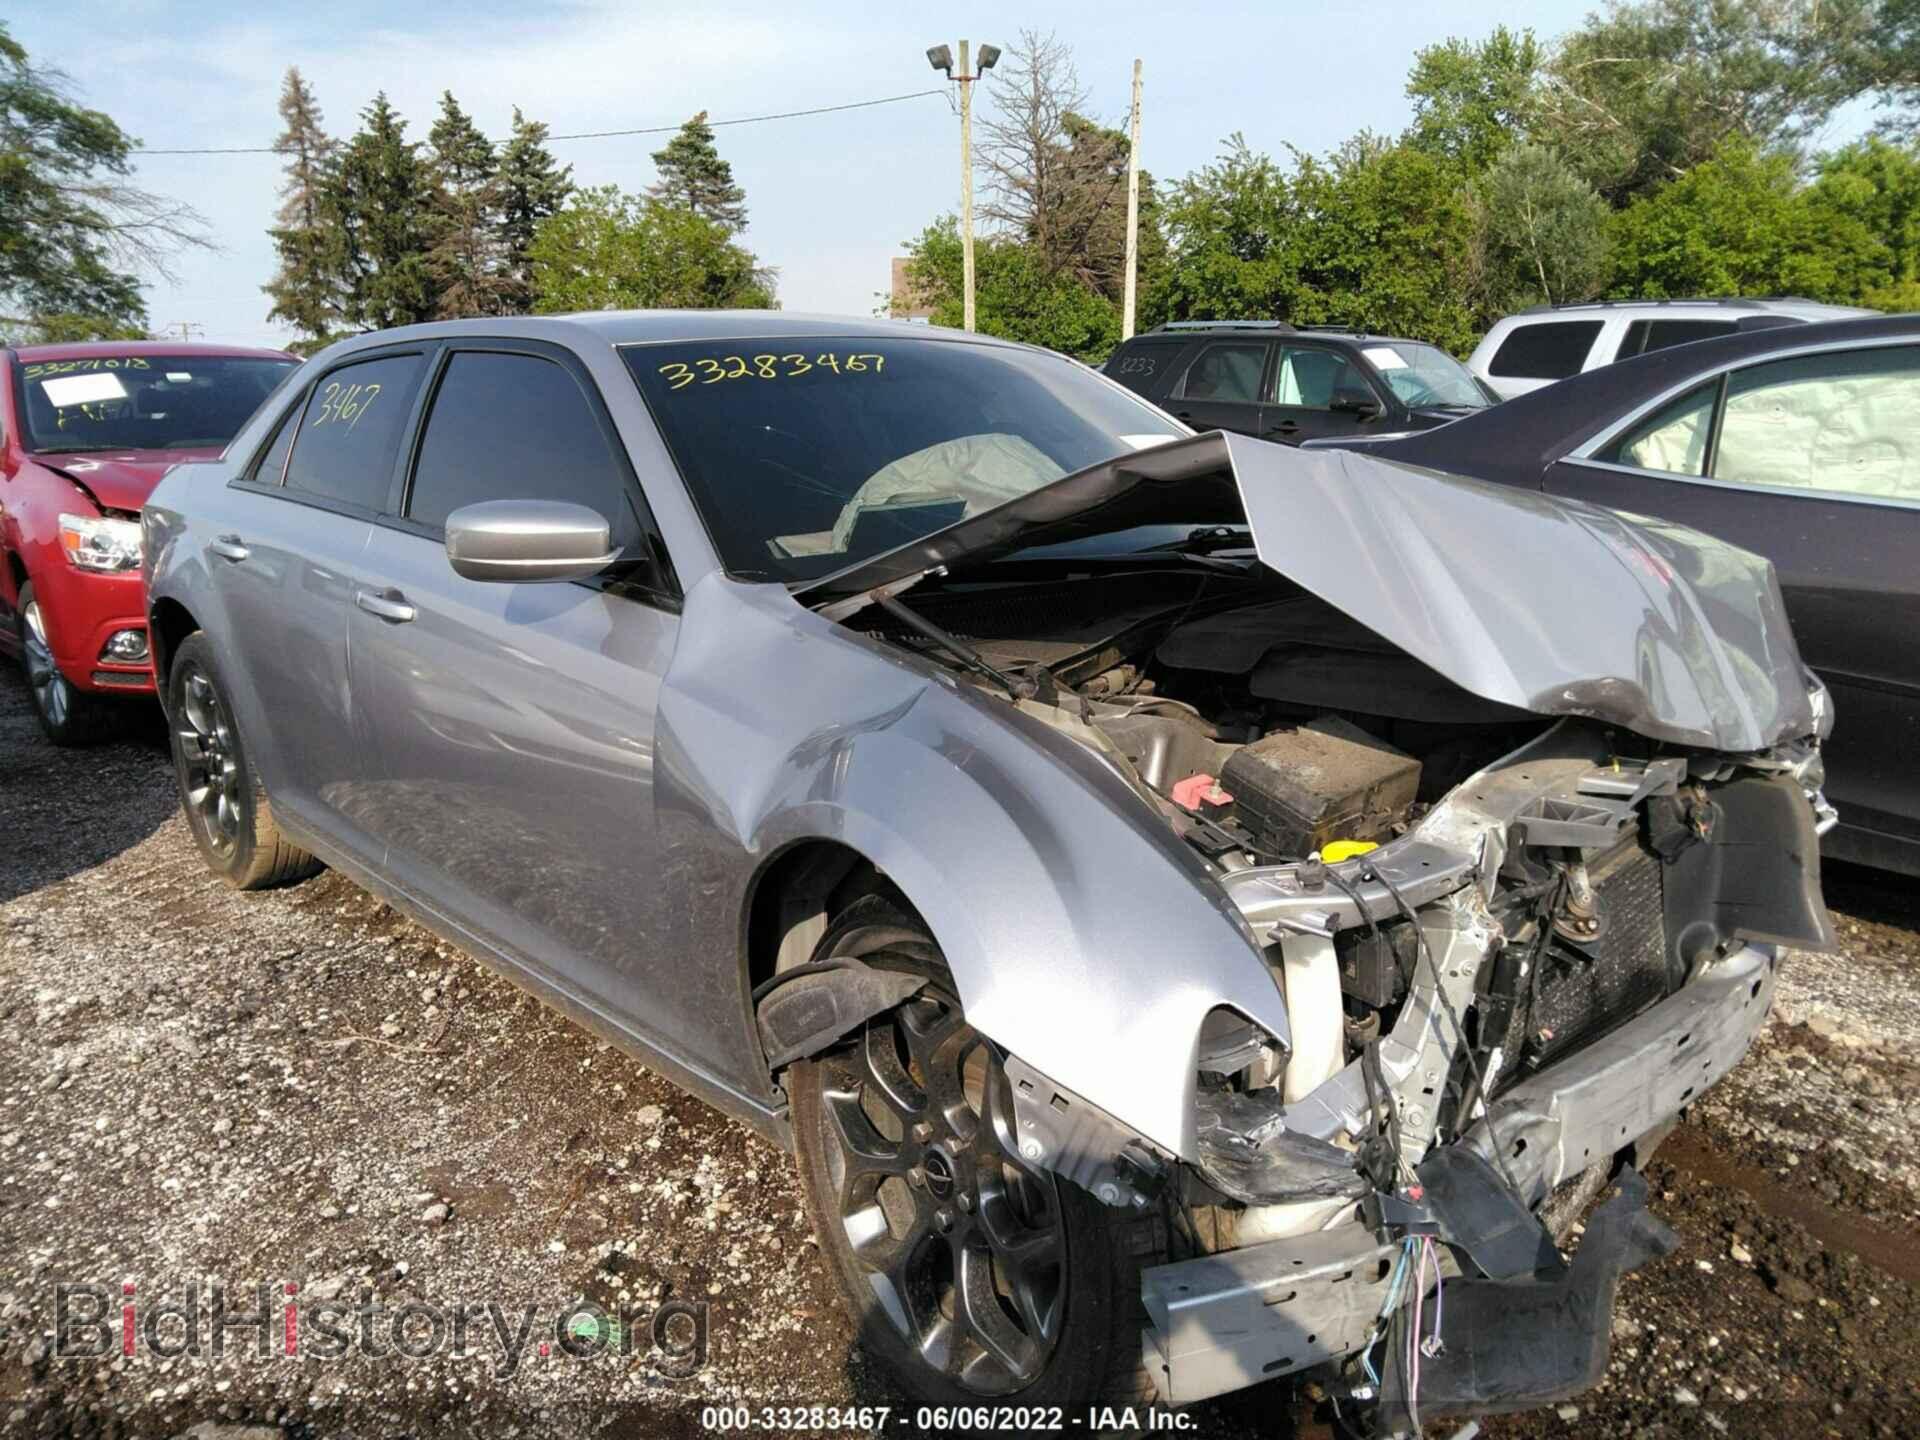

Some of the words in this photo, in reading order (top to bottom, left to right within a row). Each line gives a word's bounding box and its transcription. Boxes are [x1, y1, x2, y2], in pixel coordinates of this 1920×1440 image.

[658, 353, 885, 390] 33283467
[1120, 356, 1157, 377] 8233
[313, 382, 381, 435] 3467
